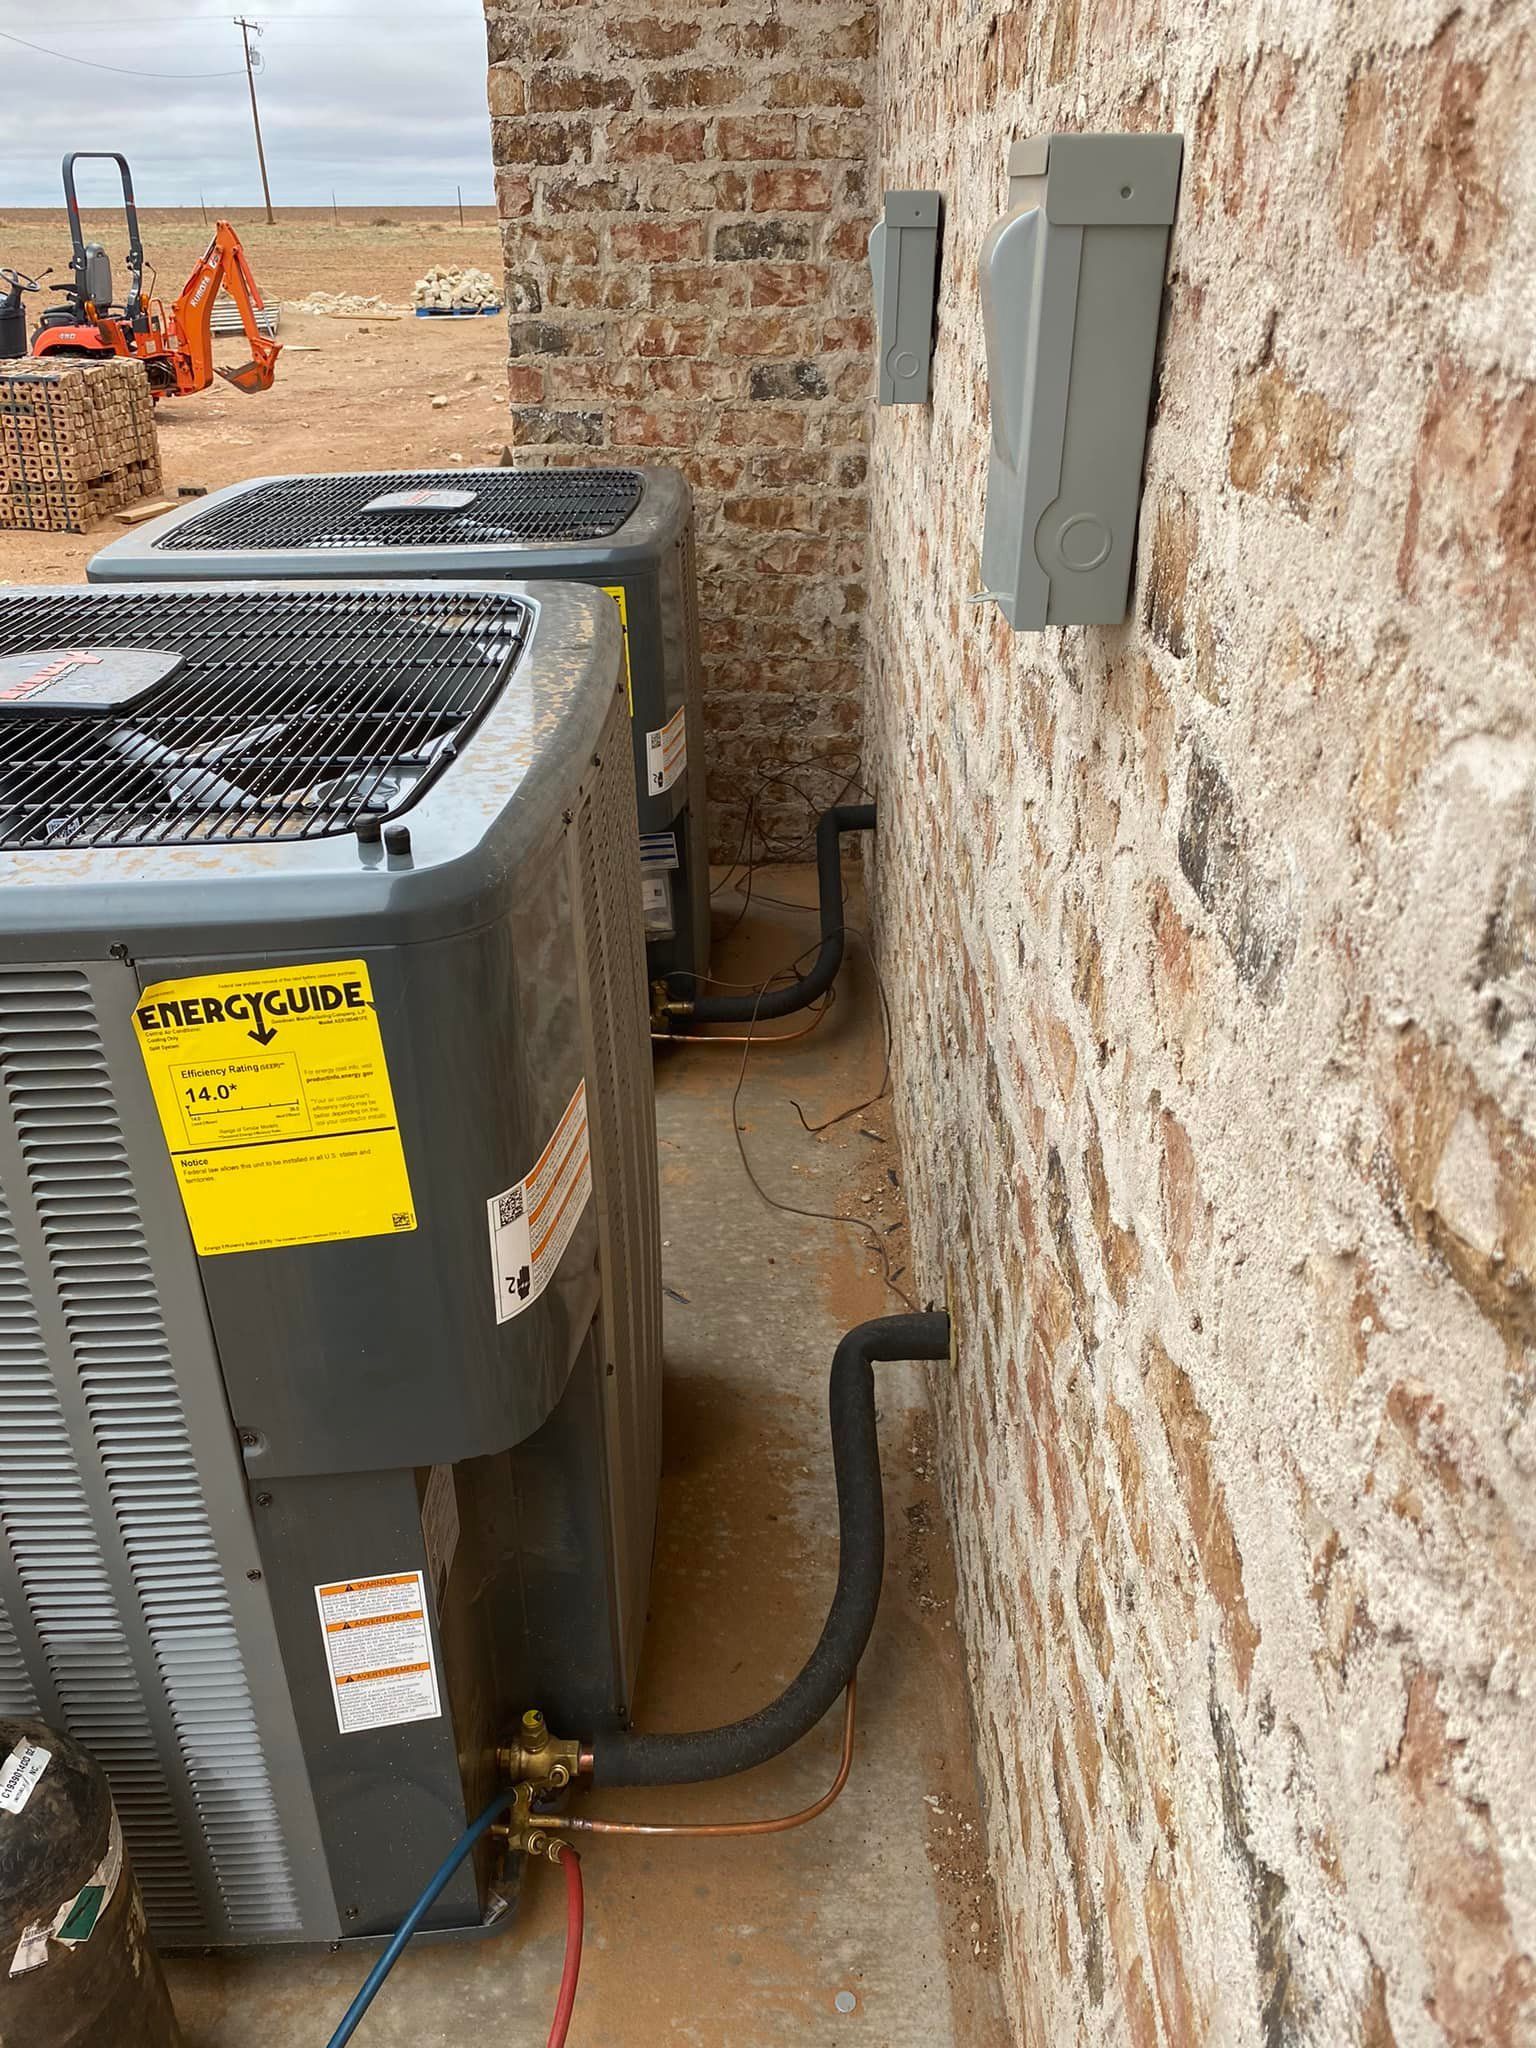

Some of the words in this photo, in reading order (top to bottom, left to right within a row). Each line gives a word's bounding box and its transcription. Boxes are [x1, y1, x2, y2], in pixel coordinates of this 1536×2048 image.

[190, 275, 211, 308] KUBOTA
[136, 982, 366, 1031] ENERGYGUIDE
[180, 1065, 227, 1080] Efficiency
[228, 1063, 260, 1075] Rating
[181, 1157, 209, 1167] Notice
[505, 1276, 516, 1293] 2
[358, 1578, 398, 1588] WARNING
